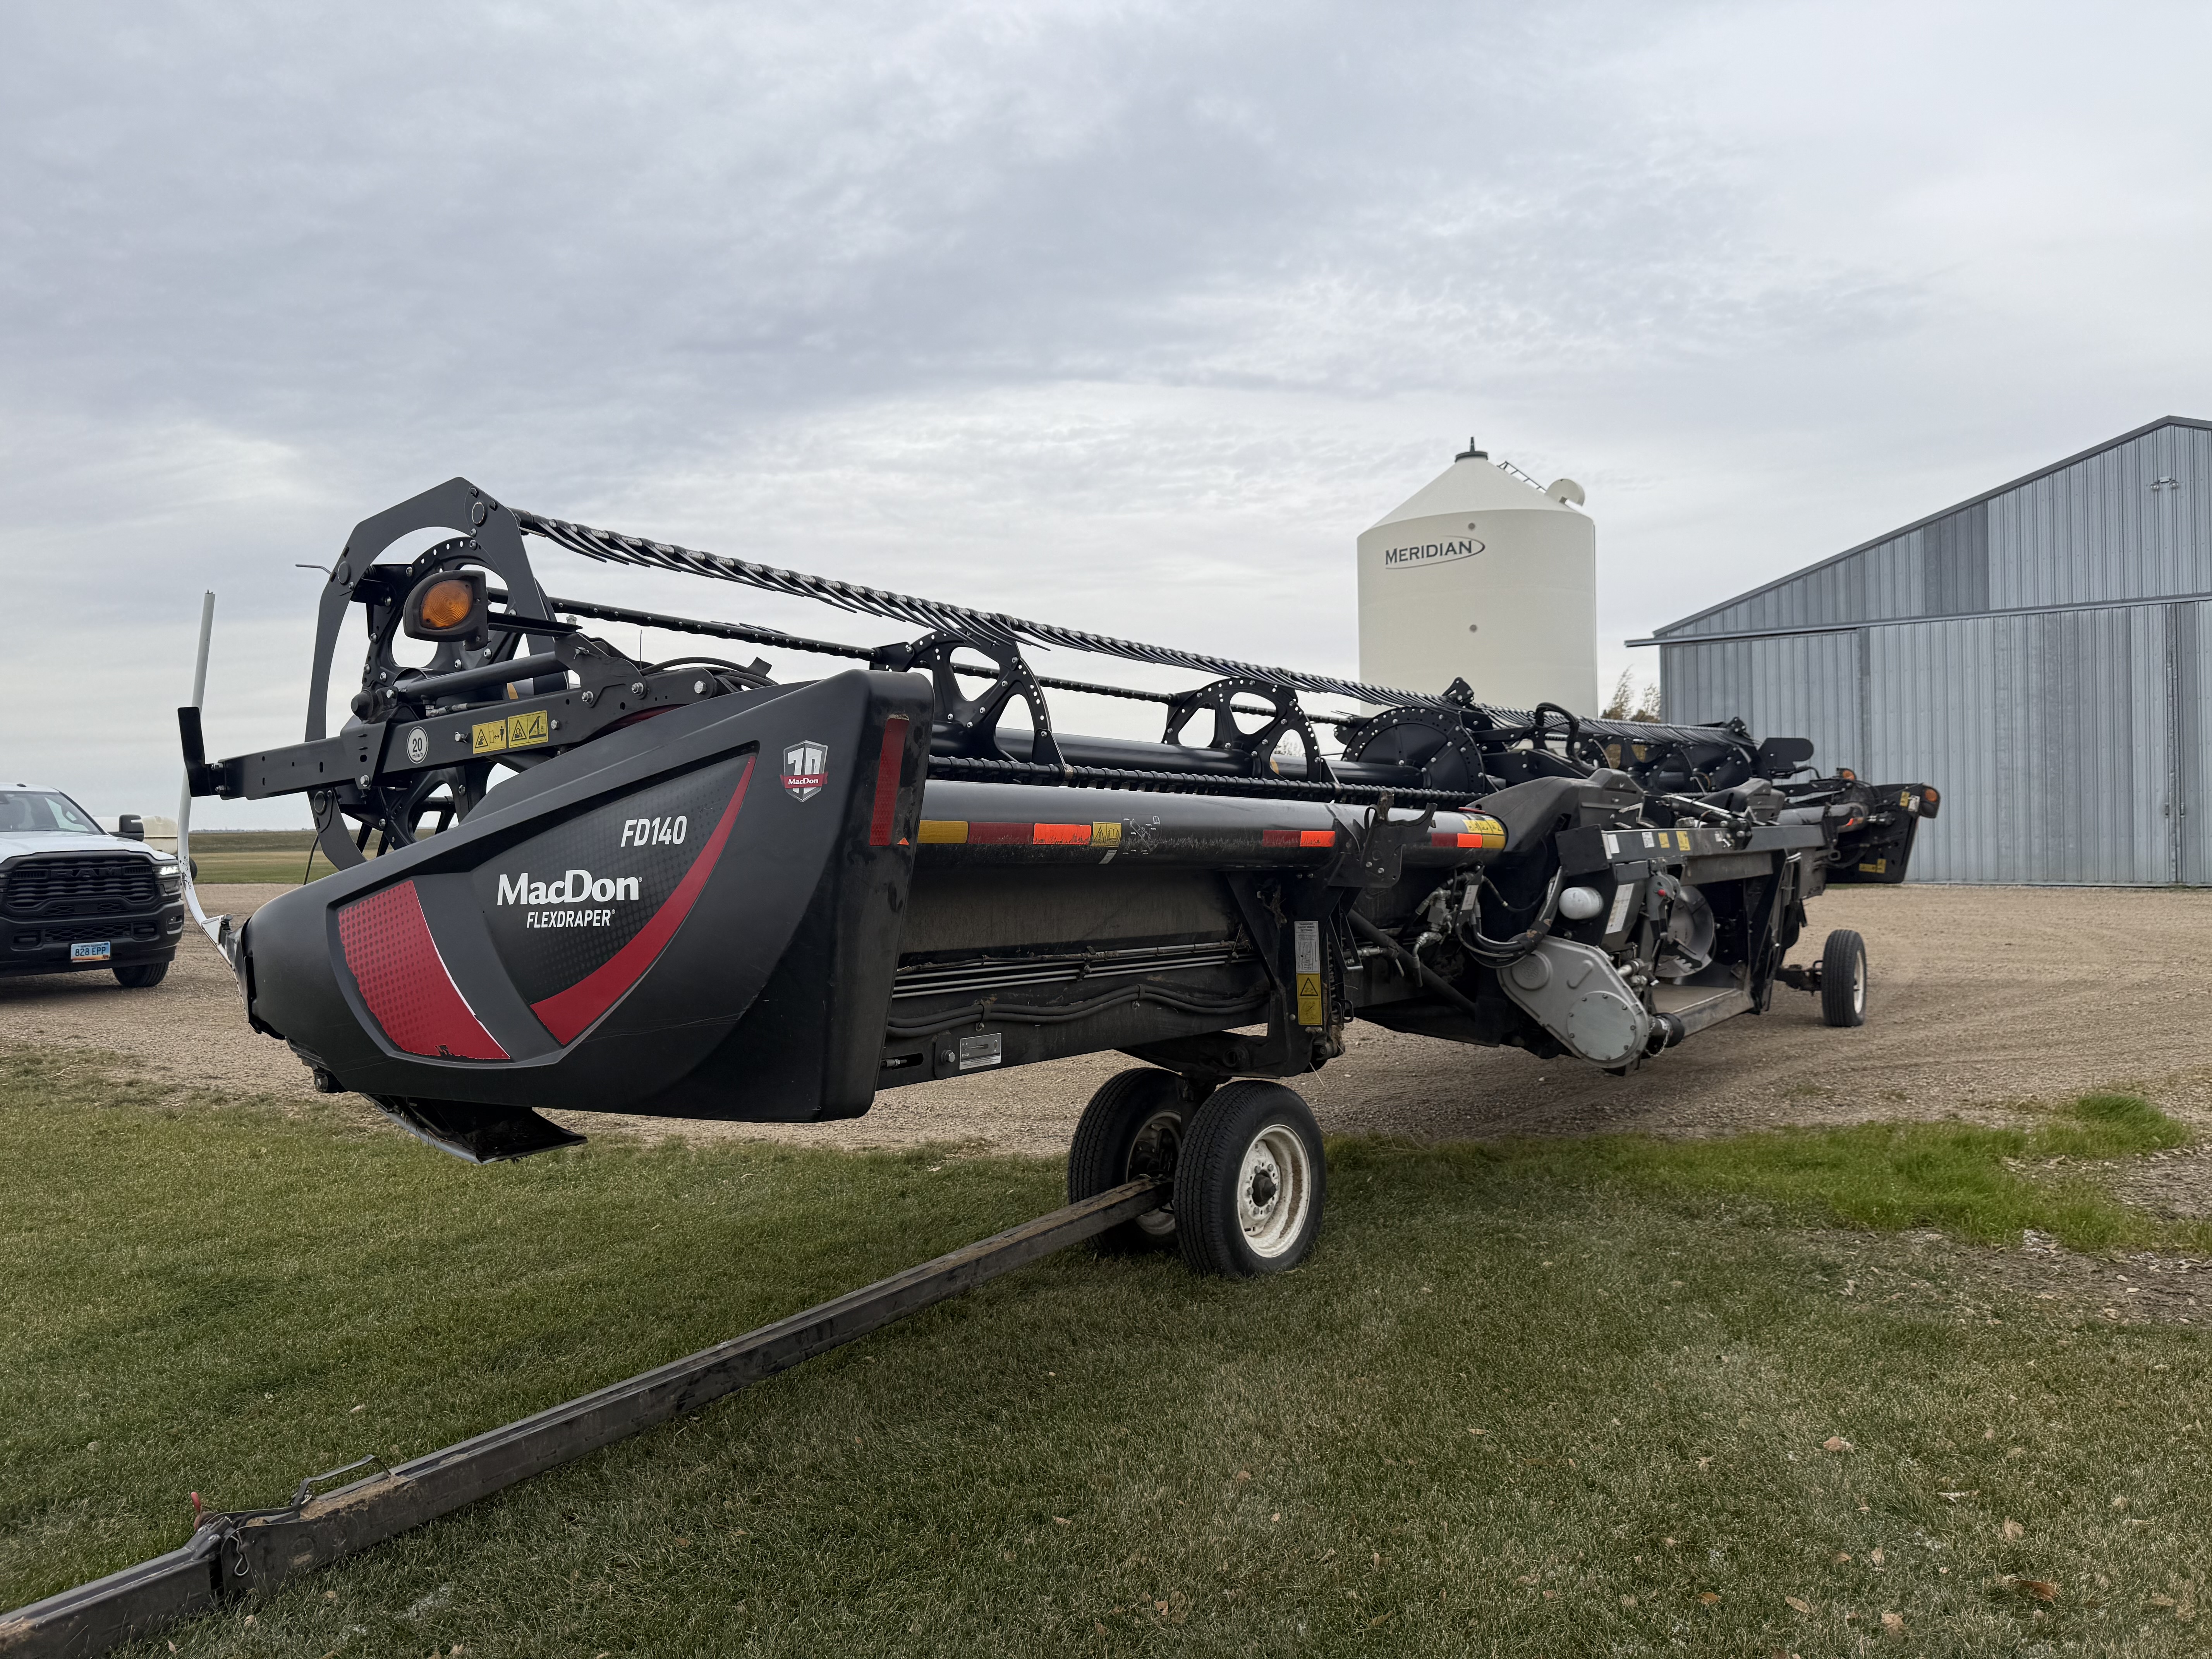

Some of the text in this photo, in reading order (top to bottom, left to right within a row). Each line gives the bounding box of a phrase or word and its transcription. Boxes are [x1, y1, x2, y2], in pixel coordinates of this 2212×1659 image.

[1385, 540, 1472, 565] MERIDIAN
[412, 737, 422, 753] 20
[620, 816, 687, 847] FD140
[497, 869, 639, 905] MacDon
[526, 909, 611, 928] FLEXDRAPER
[75, 946, 106, 956] 828 EPP
